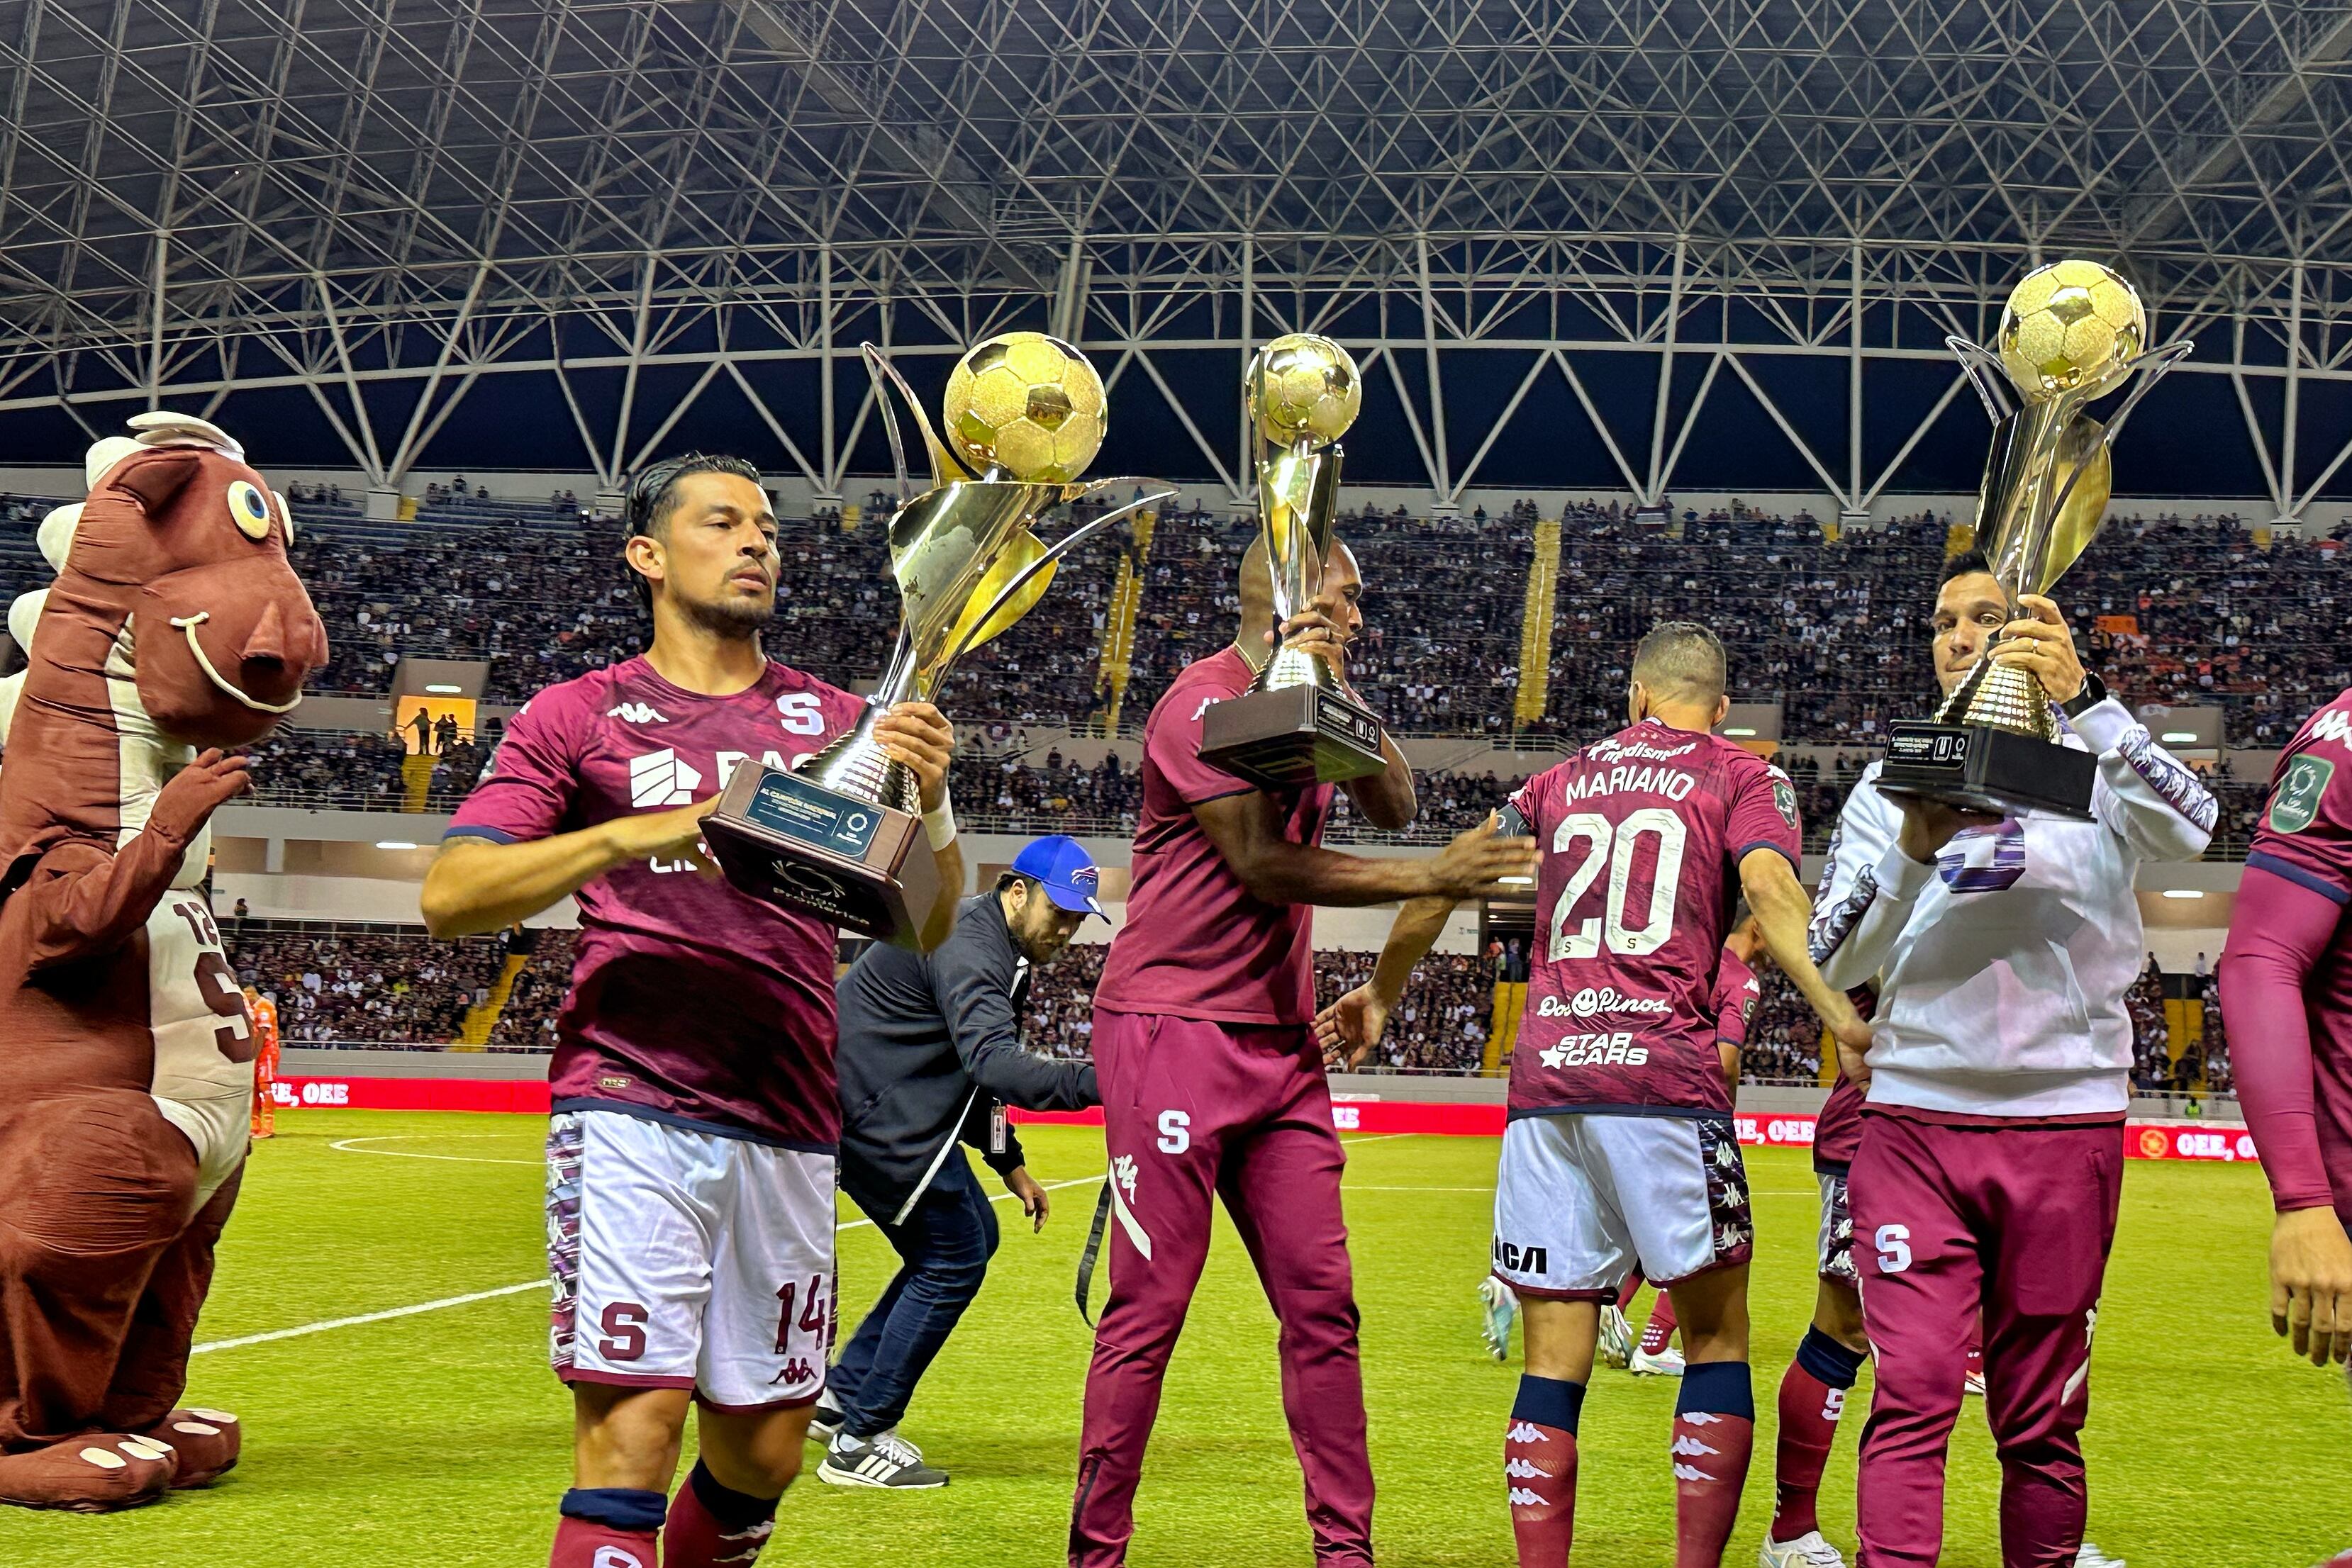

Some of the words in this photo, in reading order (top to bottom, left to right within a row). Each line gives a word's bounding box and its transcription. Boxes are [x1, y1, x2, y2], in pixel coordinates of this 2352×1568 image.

[776, 692, 825, 736] S
[1566, 765, 1695, 806] MARIANO
[1547, 808, 1687, 963] 20
[1597, 987, 1673, 1014] Pinos
[1557, 1032, 1633, 1051] STAR
[1565, 1048, 1649, 1066] CARS
[303, 1082, 350, 1104] OEE
[1157, 1109, 1191, 1154] S
[1875, 1223, 1912, 1273] S
[598, 1301, 649, 1361] S
[774, 1274, 825, 1354] 14
